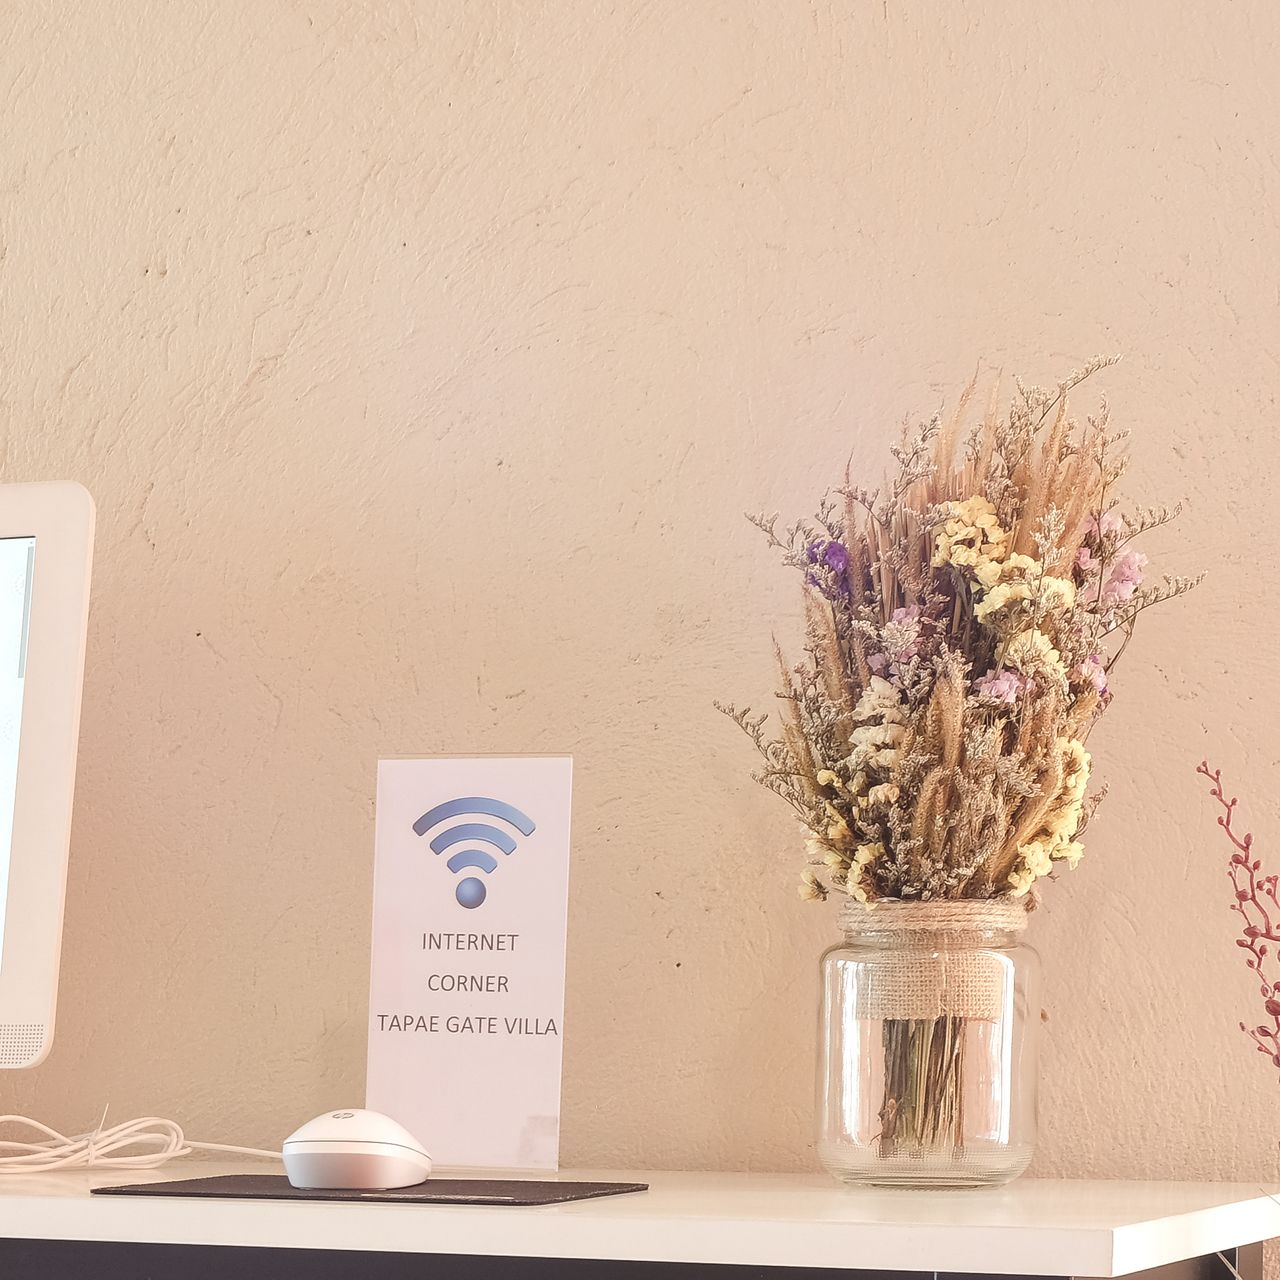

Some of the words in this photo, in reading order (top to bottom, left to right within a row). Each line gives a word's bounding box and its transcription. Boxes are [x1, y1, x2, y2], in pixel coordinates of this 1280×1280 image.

[422, 932, 519, 951] INTERNET
[427, 974, 509, 993] CORNER
[377, 1014, 440, 1033] TAPAE
[446, 1016, 498, 1034] GATE
[504, 1017, 558, 1036] VILLA
